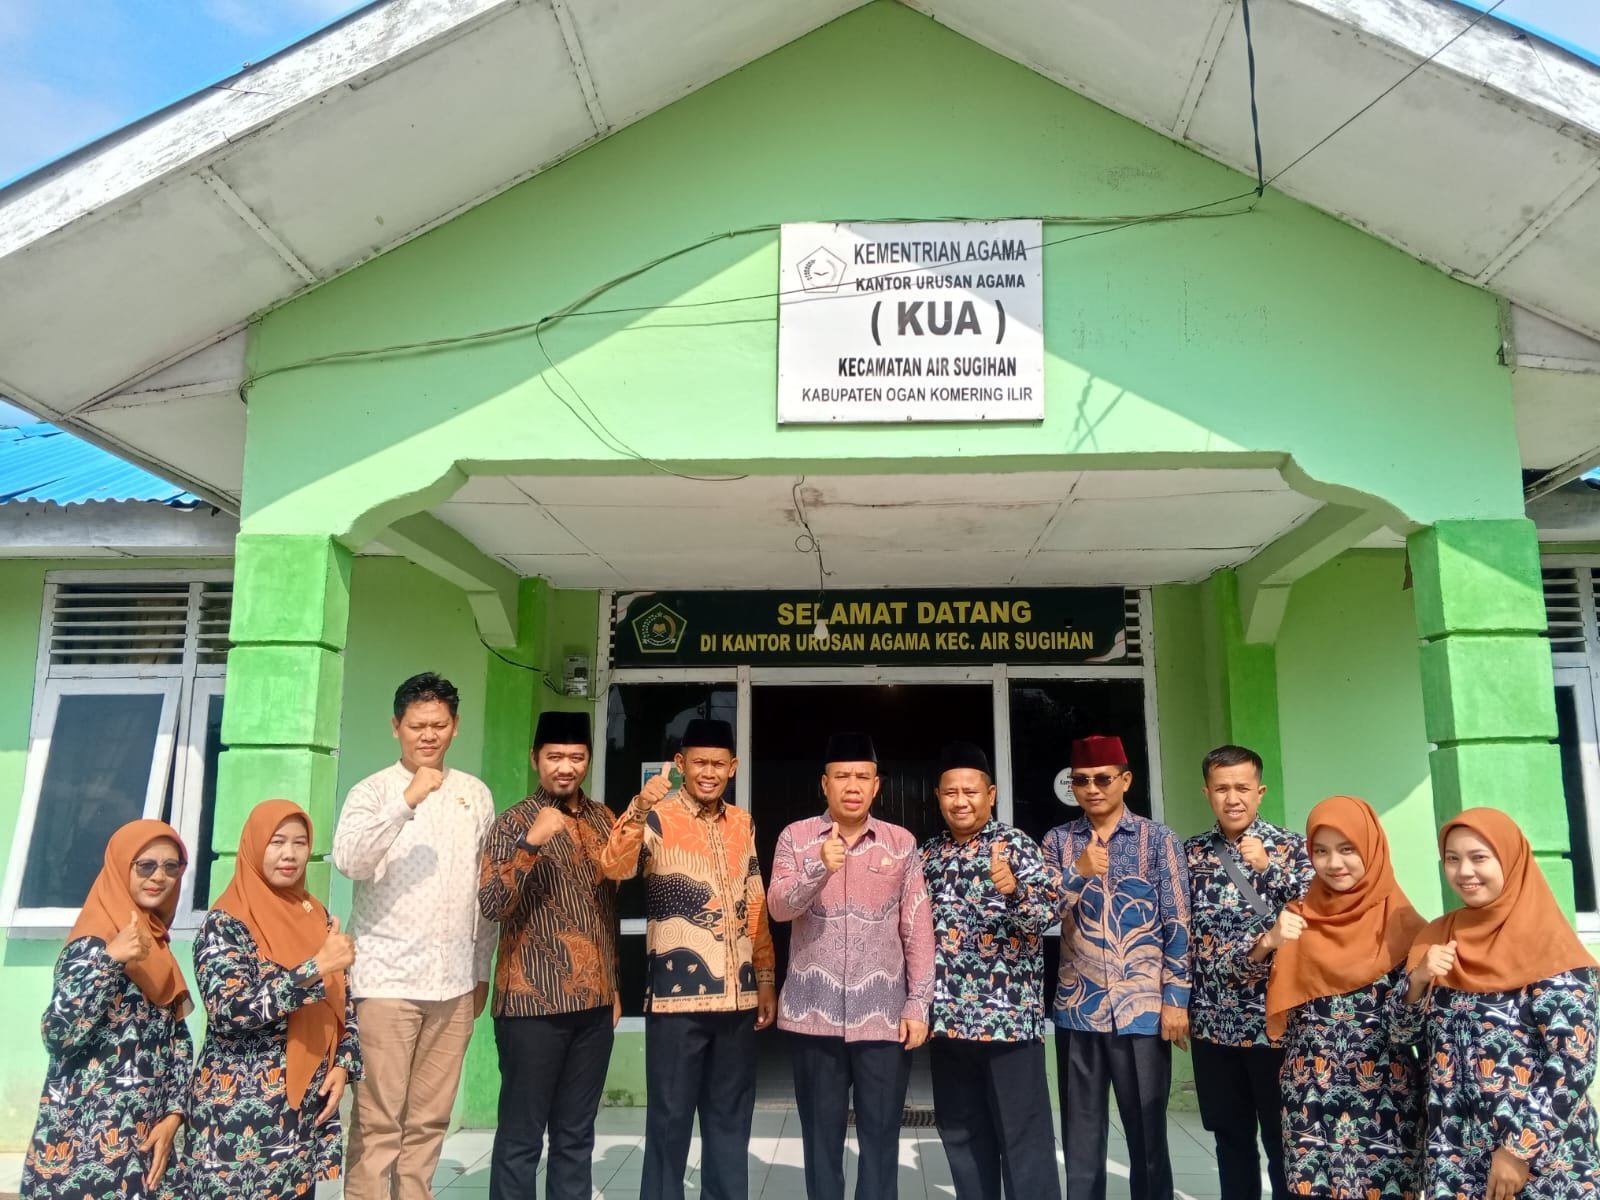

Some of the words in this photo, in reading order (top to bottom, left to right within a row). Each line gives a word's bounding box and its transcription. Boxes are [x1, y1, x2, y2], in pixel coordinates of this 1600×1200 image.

[854, 241, 960, 264] KEMENTRIAN
[966, 240, 1027, 262] AGAMA
[856, 276, 911, 292] KANTOR
[917, 275, 972, 290] URUSAN
[976, 274, 1025, 288] AGAMA
[838, 357, 922, 377] KECAMATAN
[926, 357, 949, 377] AIR
[953, 356, 1017, 377] SUGIHAN
[802, 388, 882, 402] KABUPATEN
[886, 387, 926, 402] OGAN
[930, 387, 1003, 402] KOMERING
[1007, 387, 1033, 401] ILIR
[777, 602, 907, 625] SELAMAT
[917, 600, 1032, 624] DATANG
[700, 634, 717, 652] DI
[722, 634, 791, 652] KANTOR
[796, 633, 865, 652] URUSAN
[870, 632, 931, 651] AGAMA
[935, 632, 975, 650] KEC.
[980, 632, 1010, 650] AIR
[1014, 631, 1094, 650] SUGIHAN
